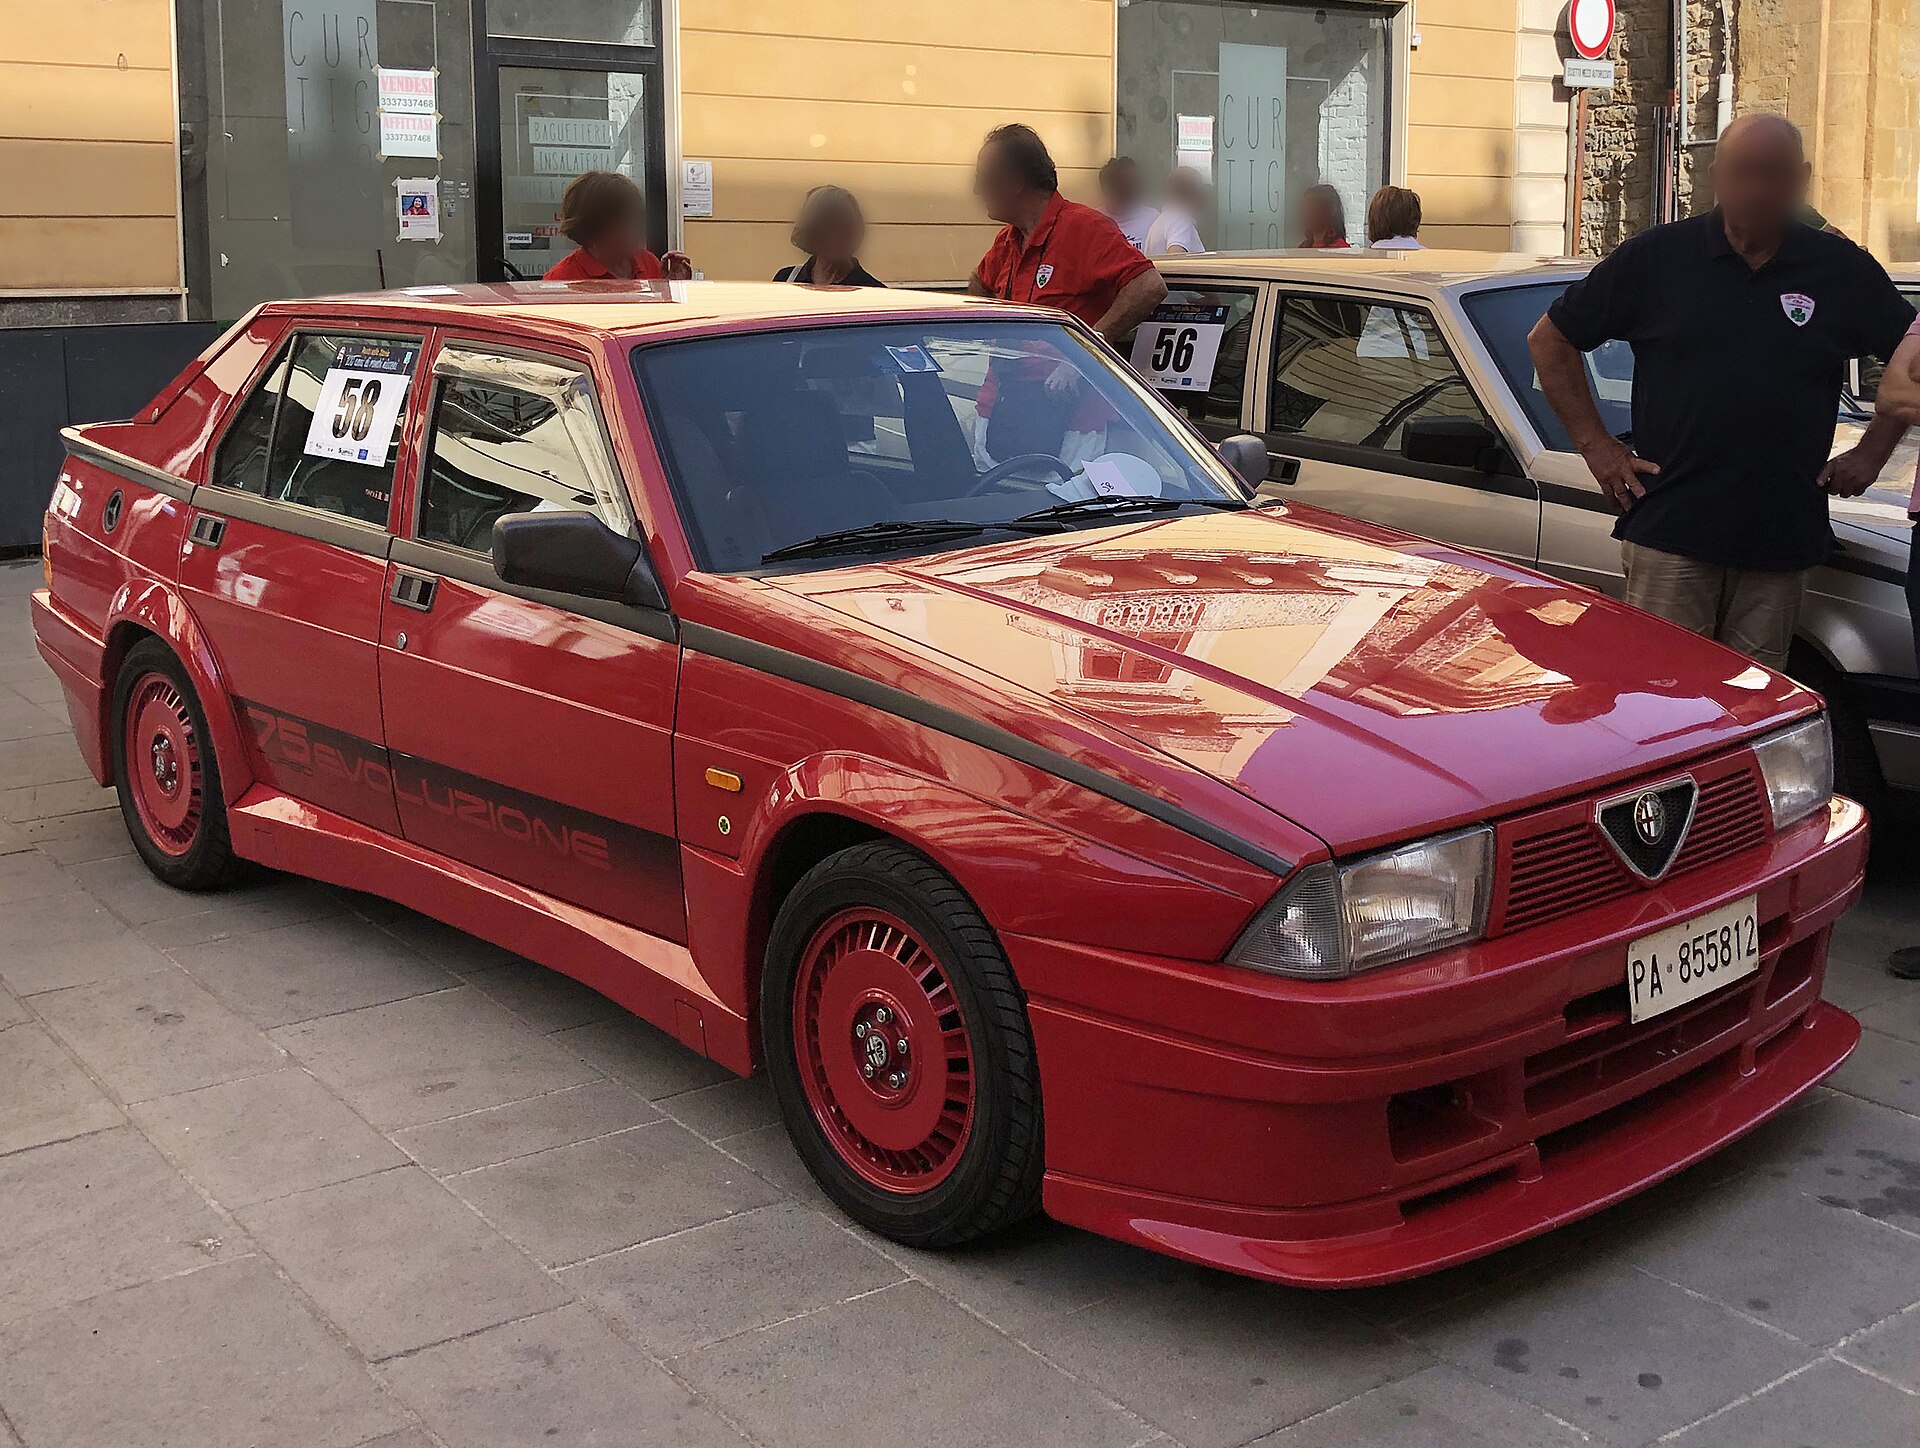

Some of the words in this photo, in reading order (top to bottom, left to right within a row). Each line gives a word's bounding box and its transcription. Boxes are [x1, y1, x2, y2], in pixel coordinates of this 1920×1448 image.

[380, 75, 434, 94] VENDESI
[381, 97, 434, 108] 3337337468
[383, 116, 433, 131] AFFITTASI
[385, 133, 432, 142] 3337337468
[1151, 327, 1198, 373] 56
[332, 378, 382, 441] 58
[247, 706, 313, 766] 75
[314, 742, 612, 872] EVOLUZIONE
[1632, 954, 1664, 1004] PA
[1678, 914, 1757, 984] 855812
